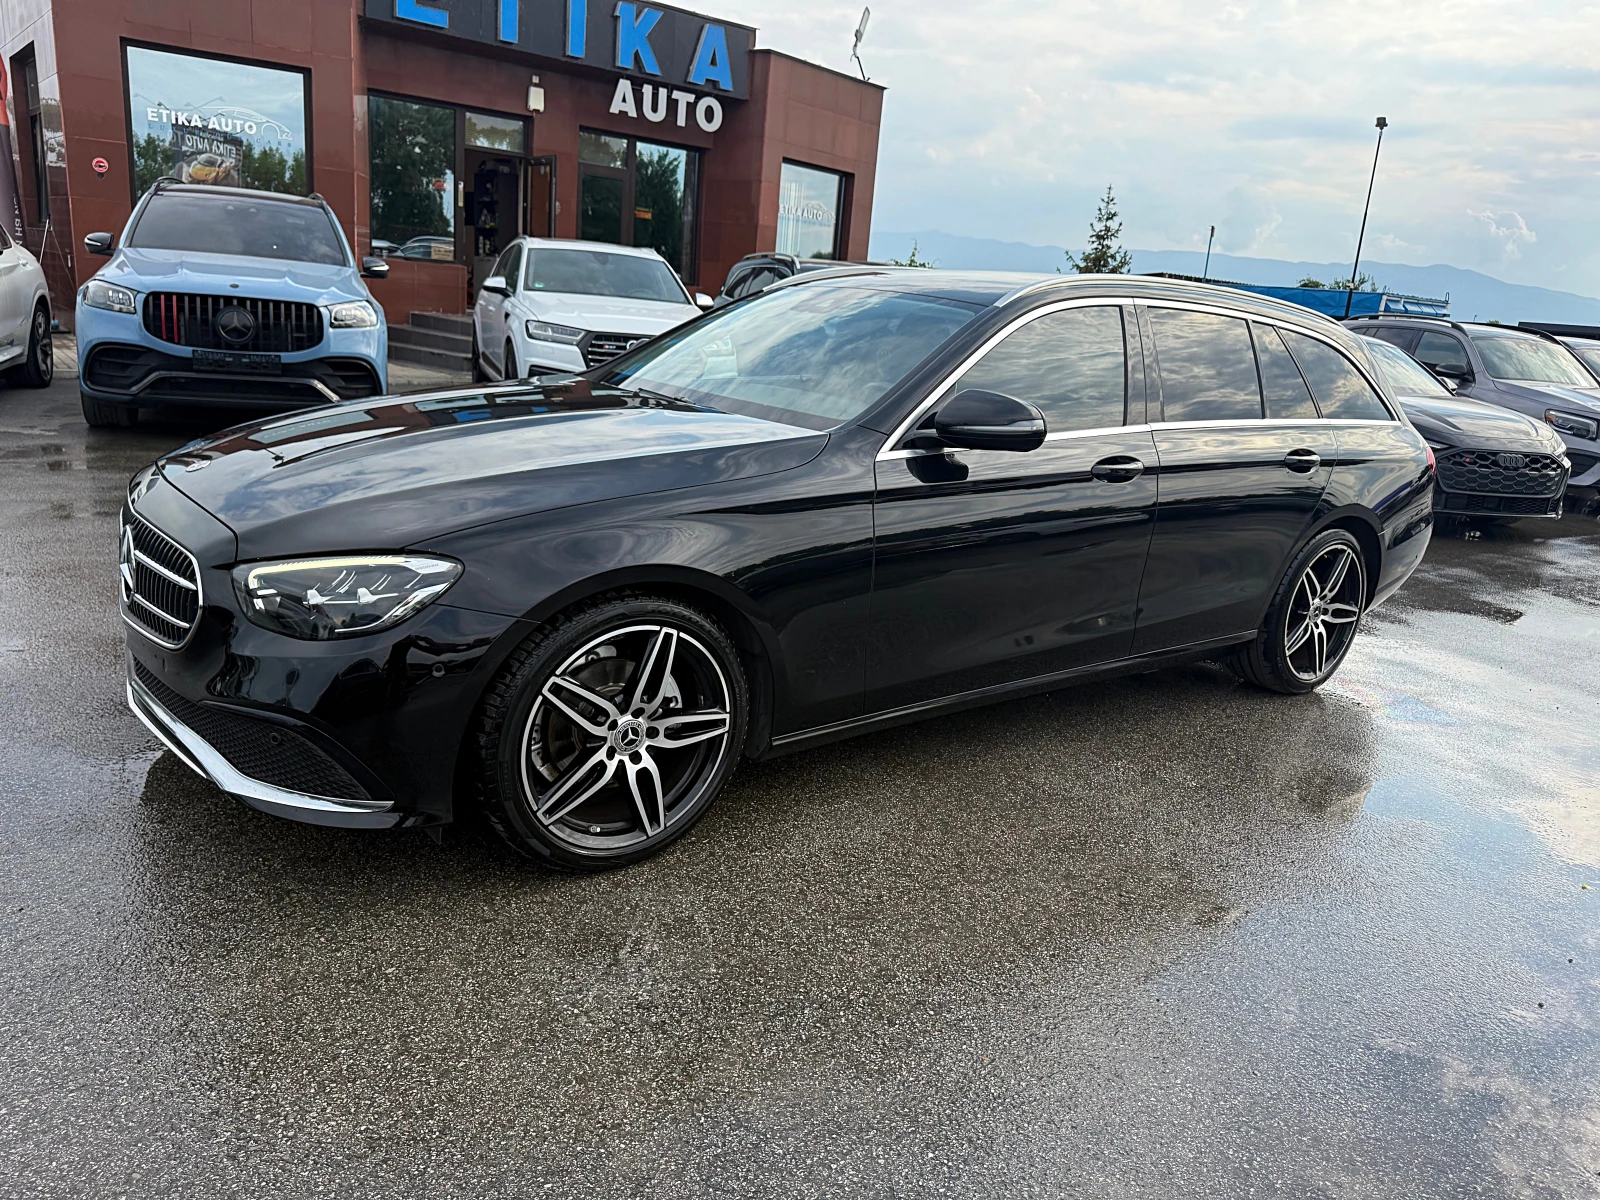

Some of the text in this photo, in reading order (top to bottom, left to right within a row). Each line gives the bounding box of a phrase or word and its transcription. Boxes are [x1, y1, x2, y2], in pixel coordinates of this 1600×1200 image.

[609, 78, 723, 133] AUTO
[146, 107, 257, 134] ETIKA AUTO
[803, 208, 823, 220] AUTO
